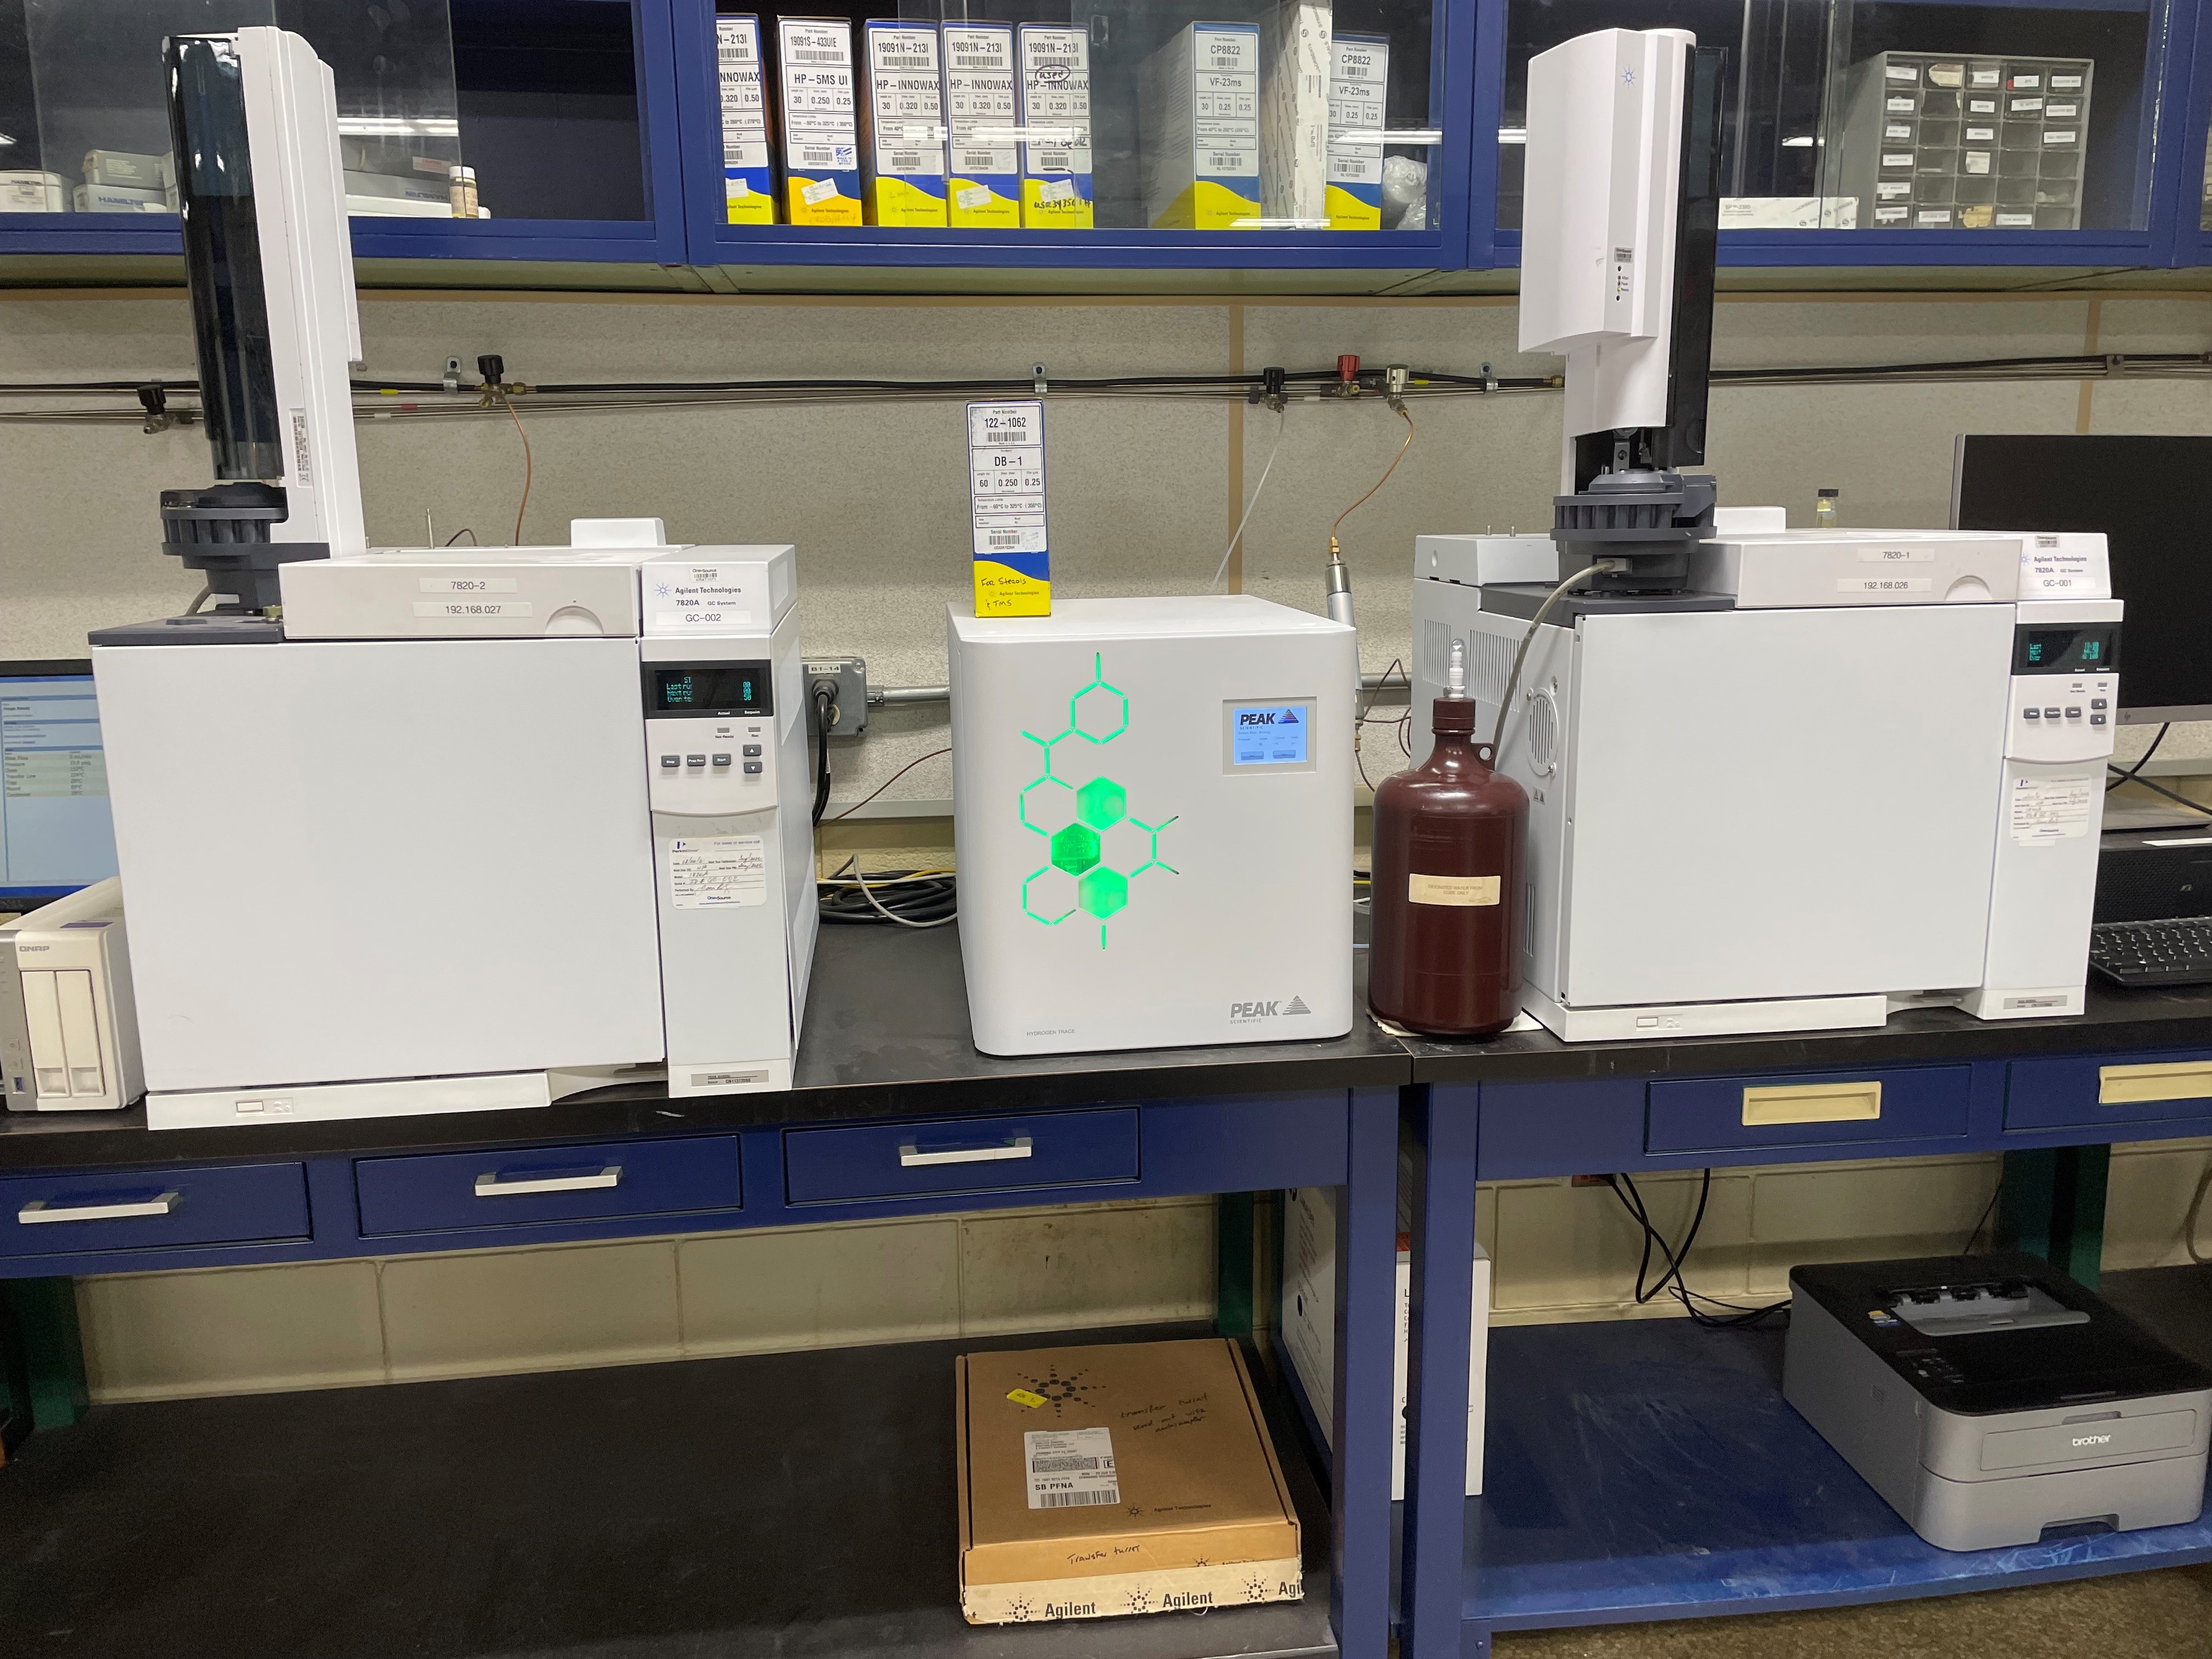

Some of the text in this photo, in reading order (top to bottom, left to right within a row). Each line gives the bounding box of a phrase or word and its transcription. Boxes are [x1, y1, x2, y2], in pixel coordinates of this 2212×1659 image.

[1211, 45, 1240, 55] CP8822
[1342, 54, 1370, 65] CP8822
[839, 75, 848, 85] UI
[1210, 77, 1242, 87] VF-23ms
[1339, 86, 1370, 96] VF-23ms
[744, 94, 759, 102] 0.50
[811, 97, 830, 105] 0.250
[998, 478, 1018, 487] 0.250
[450, 581, 486, 590] 7820-2
[445, 605, 501, 614] 192.168.027
[686, 613, 721, 622] GC-002
[1240, 713, 1276, 726] PEAK
[1231, 1001, 1279, 1018] PEAK
[2072, 1434, 2112, 1447] brother
[1163, 1591, 1214, 1610] Agilent
[1045, 1602, 1096, 1620] Agilent
